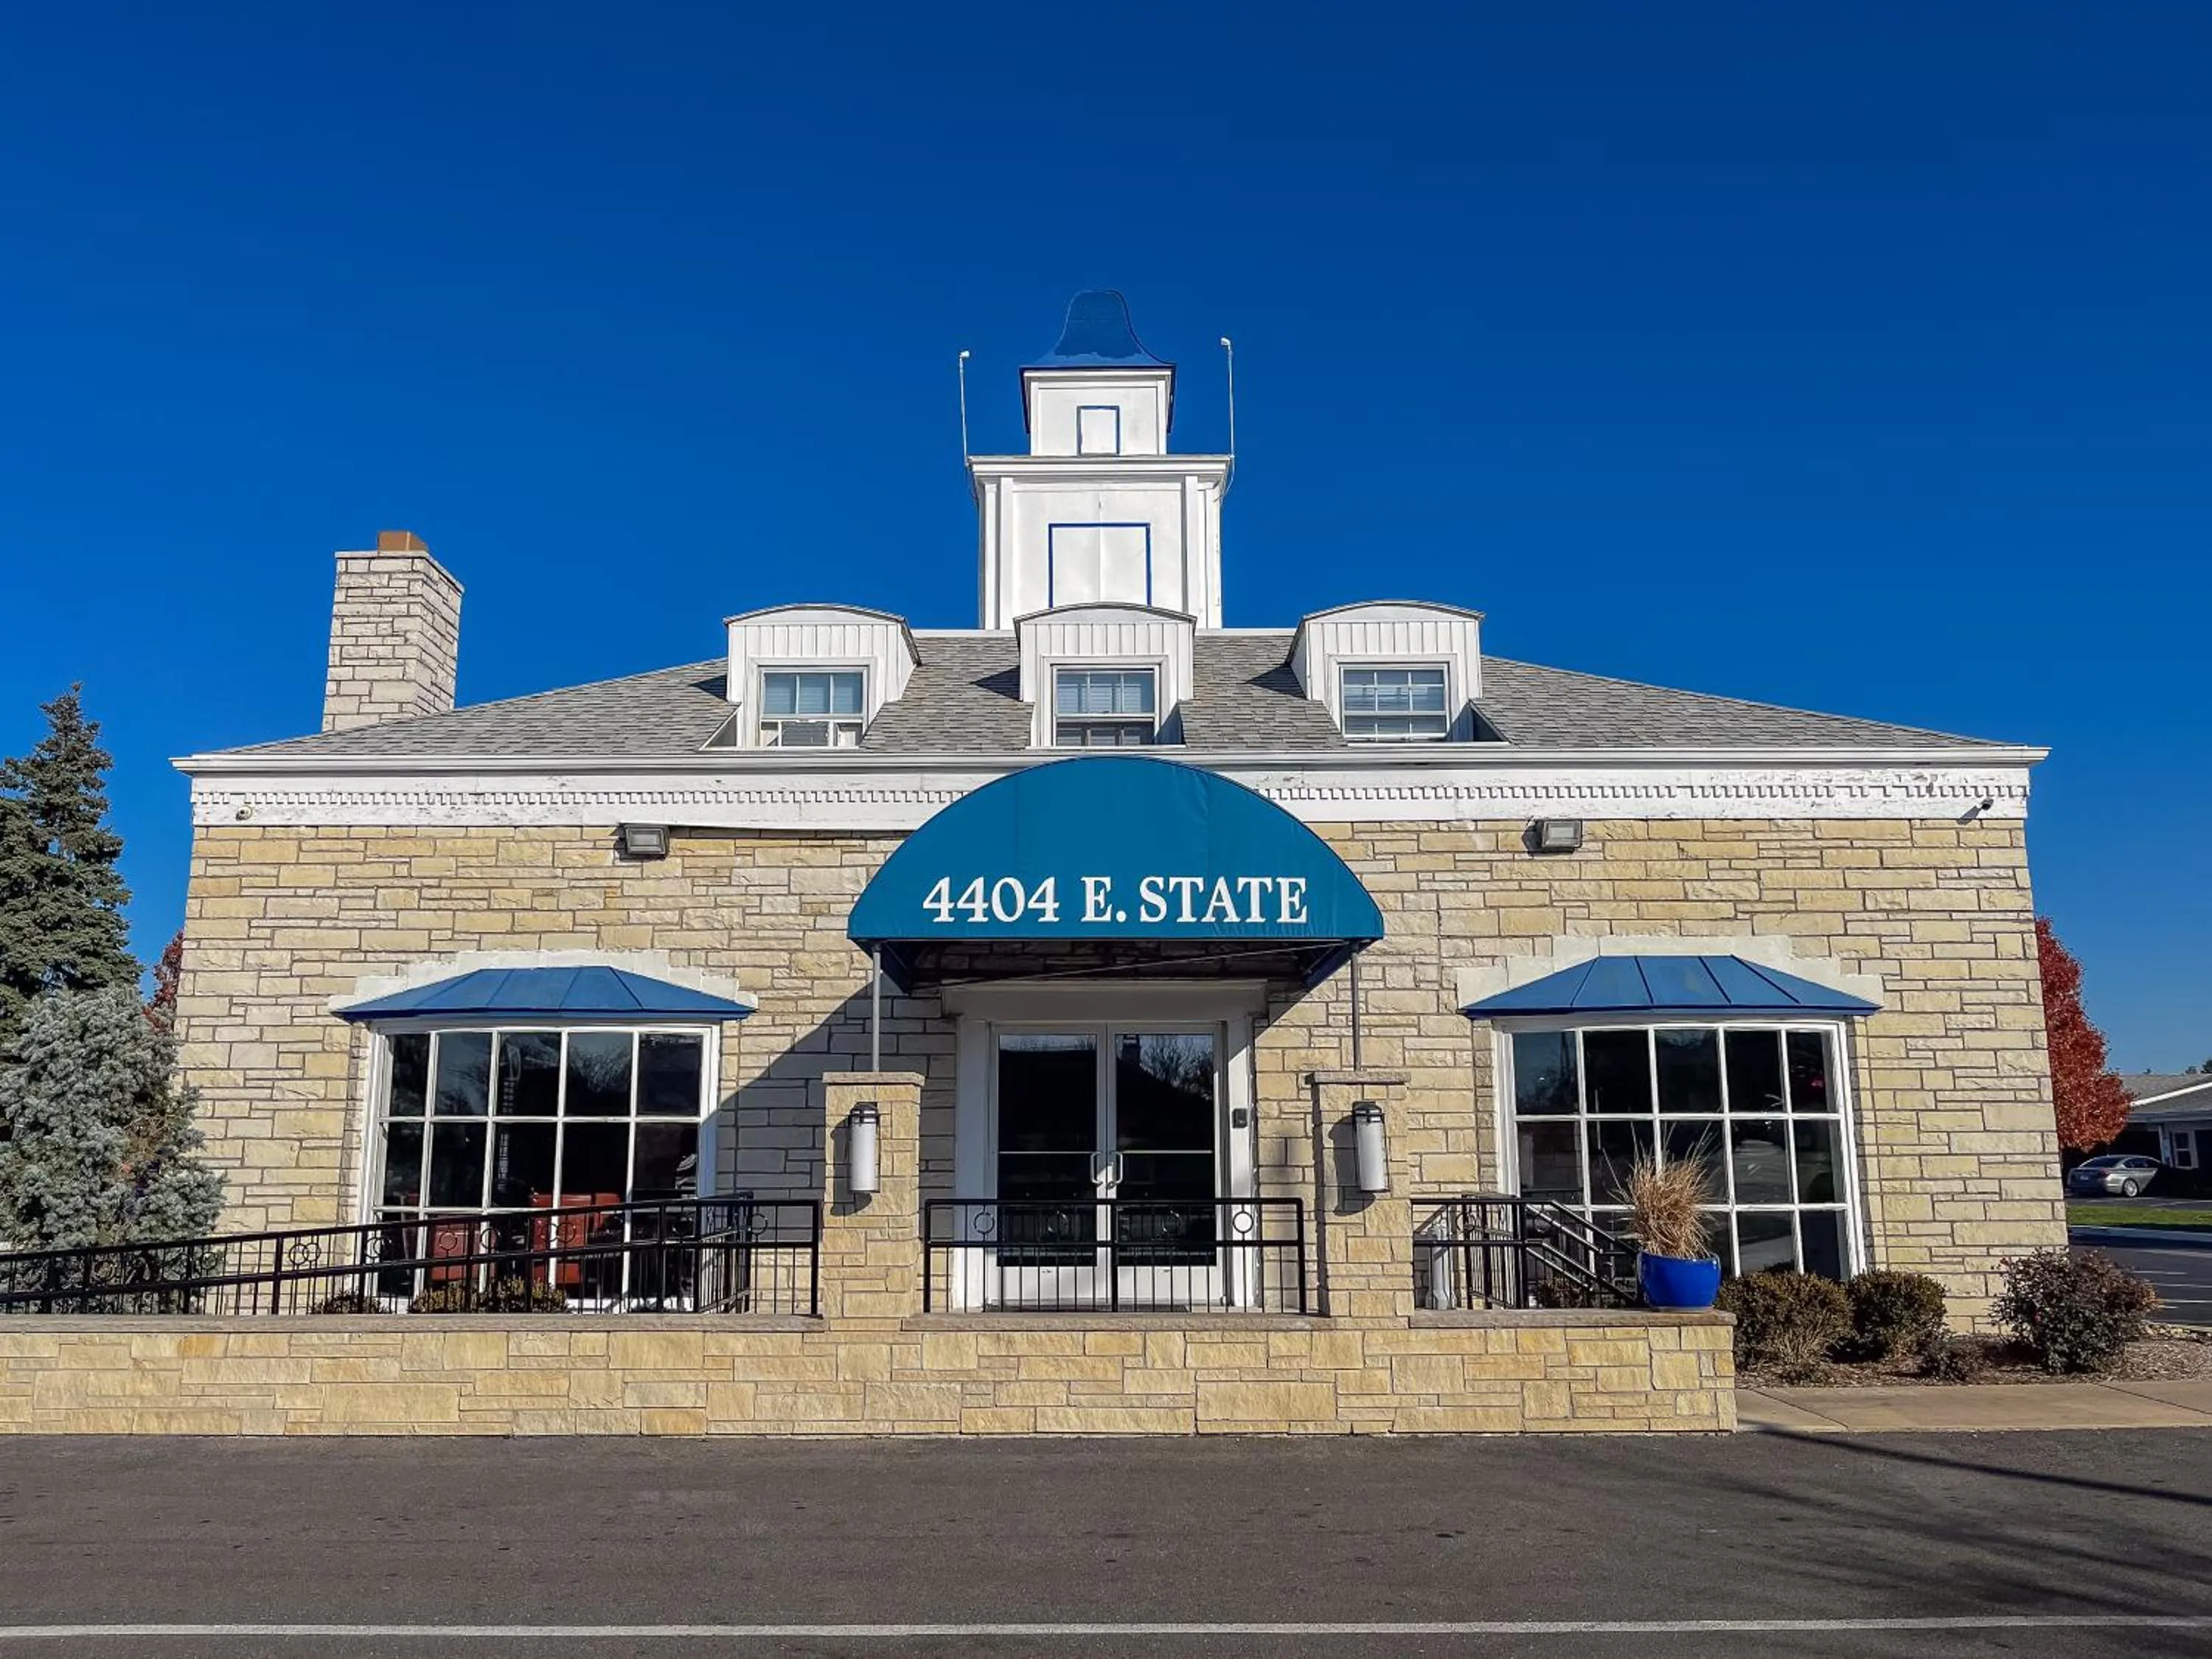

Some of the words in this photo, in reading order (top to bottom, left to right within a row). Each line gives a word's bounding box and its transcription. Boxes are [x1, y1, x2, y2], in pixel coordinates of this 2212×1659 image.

[922, 877, 1060, 922] 4404
[1080, 877, 1127, 922] E.
[1139, 876, 1307, 923] STATE
